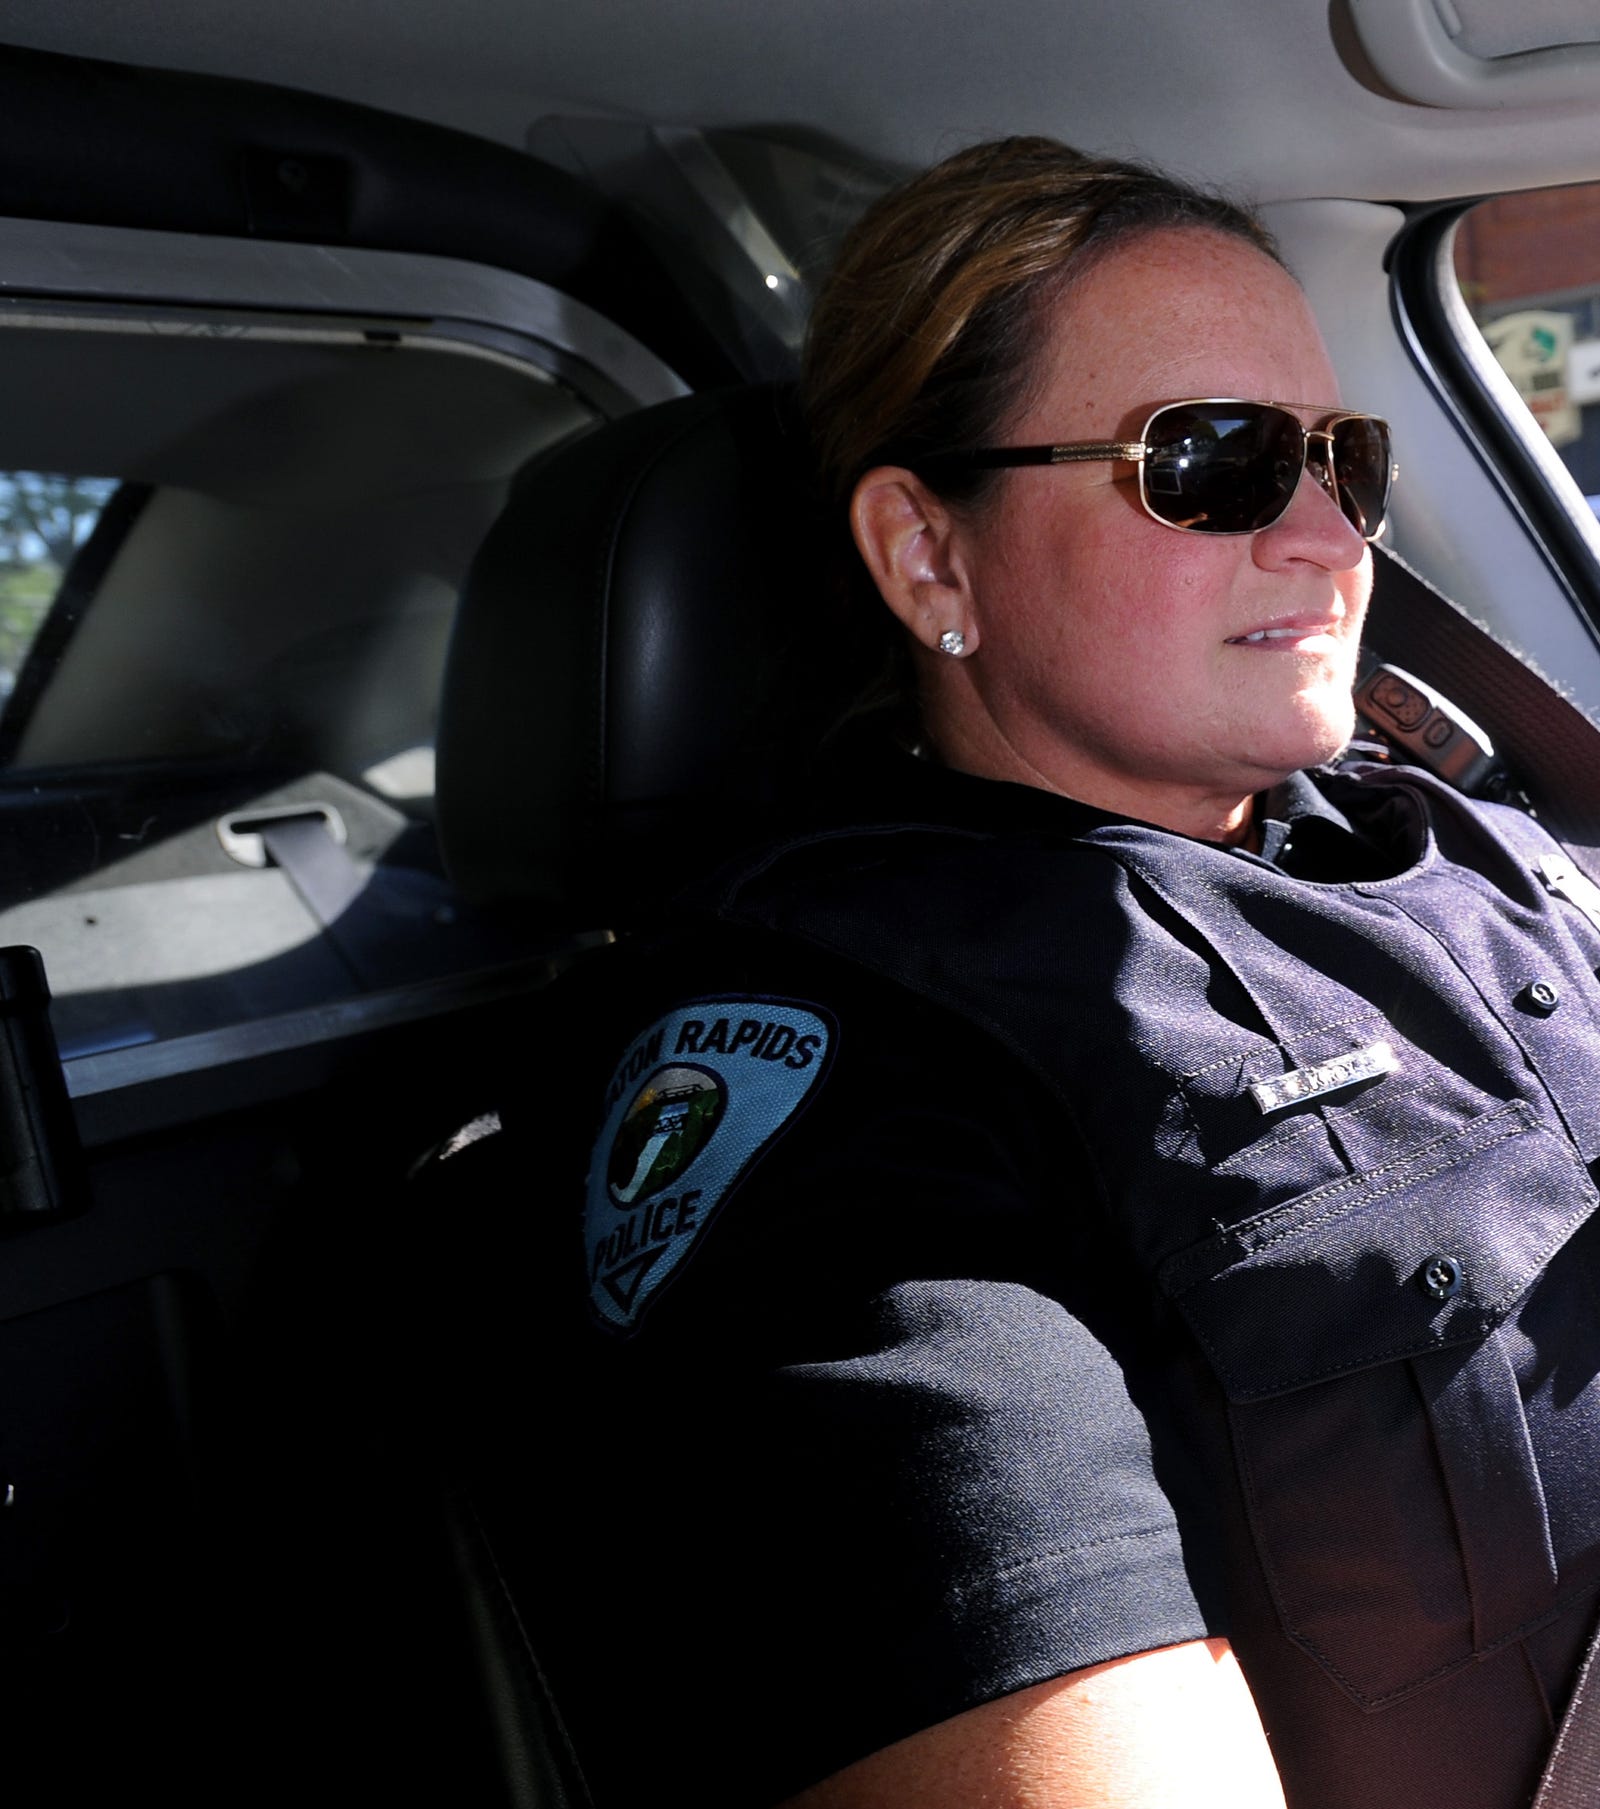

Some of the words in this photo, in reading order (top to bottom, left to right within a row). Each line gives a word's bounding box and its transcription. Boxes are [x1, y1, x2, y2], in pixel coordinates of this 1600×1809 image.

[608, 1027, 666, 1112] ATON
[673, 1017, 823, 1070] RAPIDS
[592, 1189, 702, 1282] POLICE
